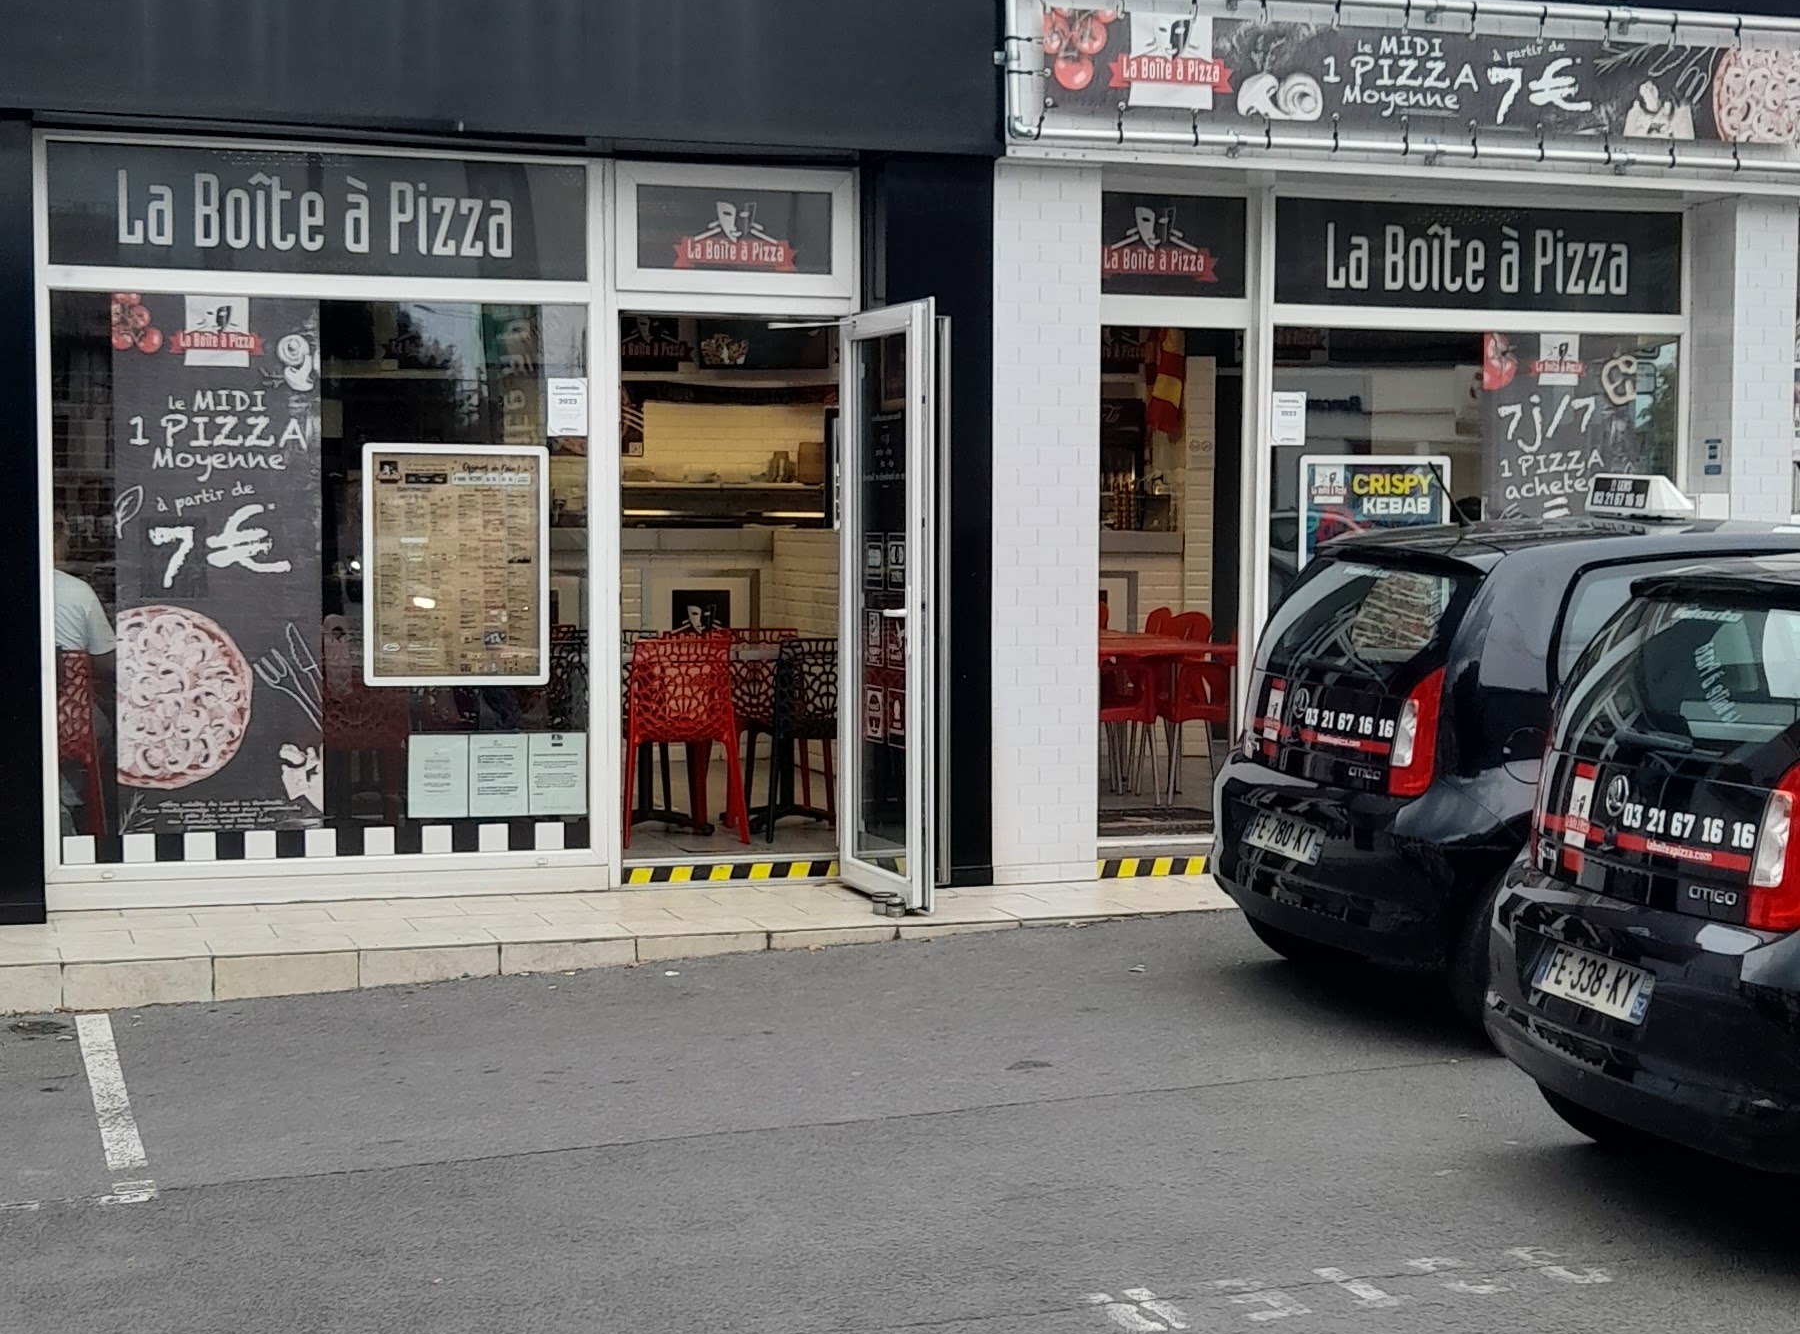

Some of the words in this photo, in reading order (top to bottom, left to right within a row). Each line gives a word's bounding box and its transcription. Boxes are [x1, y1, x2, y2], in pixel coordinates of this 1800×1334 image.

[1357, 39, 1373, 54] le
[1379, 35, 1444, 57] MIDI
[1505, 44, 1544, 66] partir
[1548, 40, 1566, 53] de
[1122, 57, 1138, 79] La
[1142, 56, 1172, 82] Boîte
[1176, 59, 1185, 82] à
[1188, 61, 1221, 83] Pizza
[1322, 56, 1341, 83] 1
[1350, 55, 1479, 93] PIZZA
[1341, 83, 1460, 117] Moyenne
[1486, 66, 1523, 125] 7
[116, 169, 174, 246] La
[194, 170, 326, 252] Boîte
[344, 174, 371, 254] à
[389, 180, 513, 259] Pizza
[686, 239, 702, 260] La
[706, 238, 737, 261] Boîte
[740, 241, 748, 262] à
[751, 243, 785, 263] Pizza
[1103, 247, 1118, 269] La
[1122, 247, 1155, 271] Boîte
[1159, 249, 1167, 271] à
[1171, 250, 1205, 272] Pizza
[1326, 221, 1369, 290] La
[1383, 222, 1486, 293] Boîte
[1500, 225, 1520, 294] à
[1533, 228, 1629, 296] Pizza
[228, 333, 255, 349] Pizza
[168, 394, 186, 411] le
[193, 389, 267, 413] MIDI
[128, 415, 150, 446] 1
[160, 413, 308, 450] PIZZA
[1497, 393, 1596, 453] 7j/7
[152, 447, 287, 482] Moyenne
[1500, 458, 1513, 477] 1
[1517, 448, 1605, 477] PIZZA
[155, 497, 170, 513] à
[174, 488, 224, 517] partir
[231, 482, 256, 497] de
[1352, 473, 1434, 495] CRISPY
[1362, 497, 1431, 515] KEBAB
[148, 525, 195, 589] 7
[1305, 707, 1319, 726] 03
[1321, 710, 1335, 729] 21
[1337, 712, 1355, 732] 67
[1358, 715, 1374, 735] 16
[1378, 718, 1395, 738] 16
[1622, 802, 1644, 829] 03
[1645, 807, 1667, 834] 21
[1670, 811, 1697, 839] 67
[1701, 816, 1724, 844] 16
[1731, 821, 1756, 849] 16
[1545, 947, 1641, 1009] FE-338-KY
